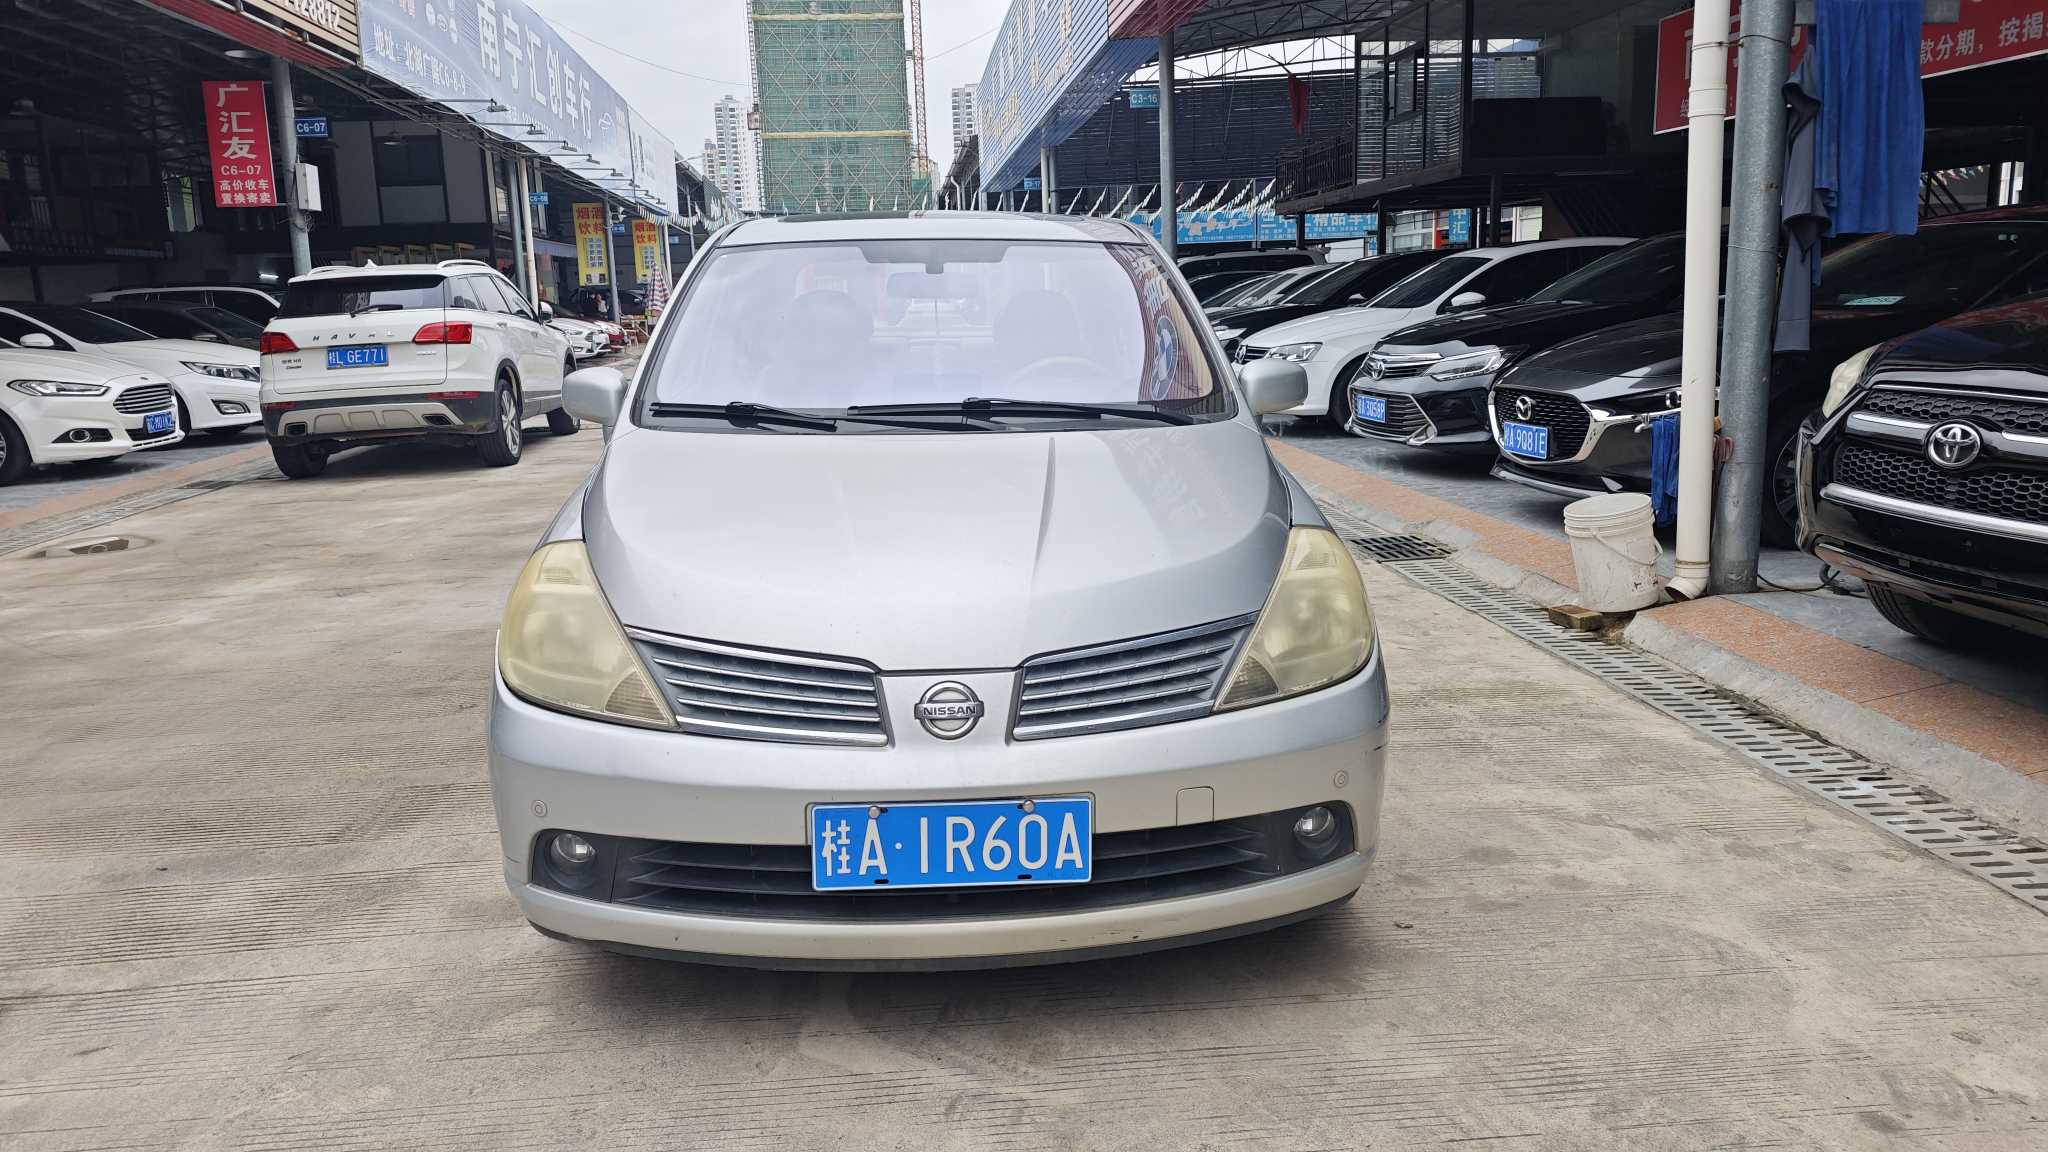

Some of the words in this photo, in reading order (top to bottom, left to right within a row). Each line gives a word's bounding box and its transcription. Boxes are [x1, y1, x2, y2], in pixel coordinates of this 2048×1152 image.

[477, 0, 591, 140] 南宁汇创车行
[216, 84, 257, 159] 广汇友
[296, 122, 325, 133] C6-07
[221, 165, 262, 176] C6-07
[218, 179, 269, 191] 高价收车
[221, 192, 271, 204] 置换寄卖
[923, 705, 977, 716] NISSAN
